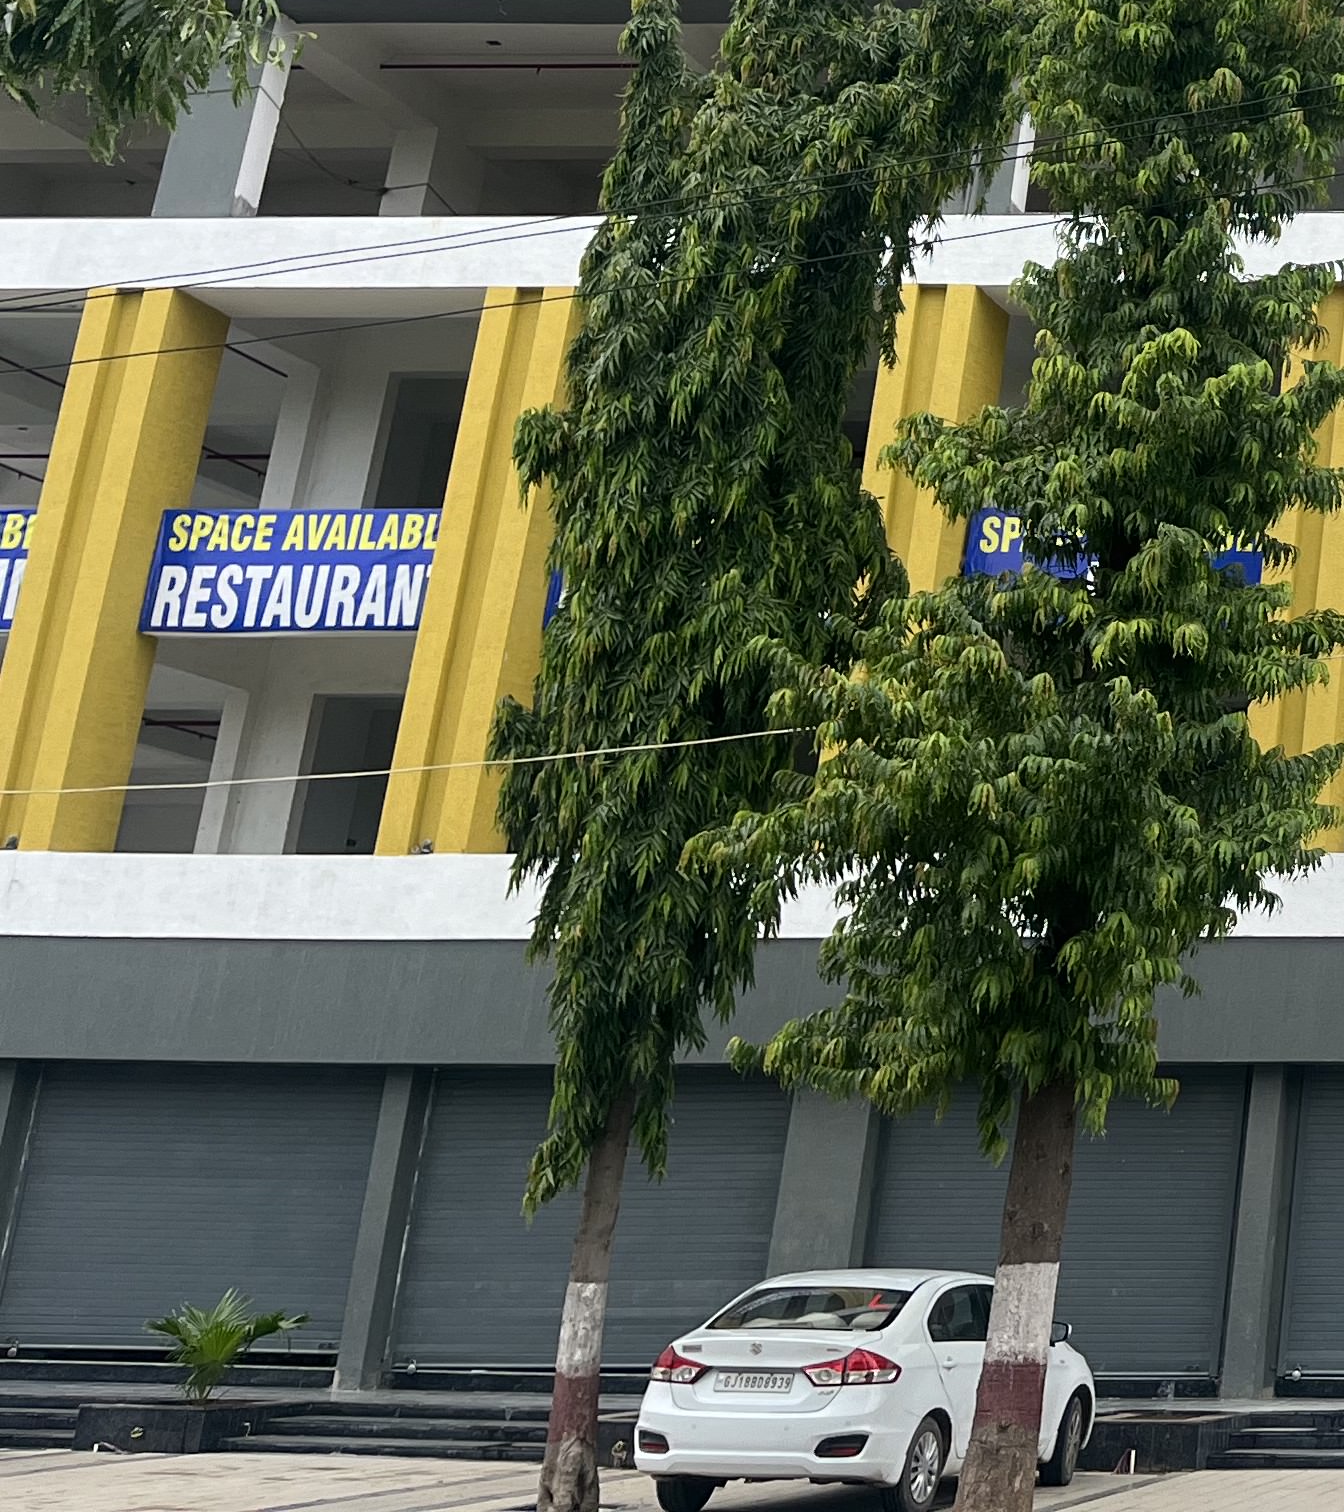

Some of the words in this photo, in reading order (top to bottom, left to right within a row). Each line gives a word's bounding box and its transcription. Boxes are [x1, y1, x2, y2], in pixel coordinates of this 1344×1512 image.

[169, 513, 277, 552] SPACE
[282, 513, 438, 551] AVAILABL
[150, 563, 433, 629] RESTAURAN
